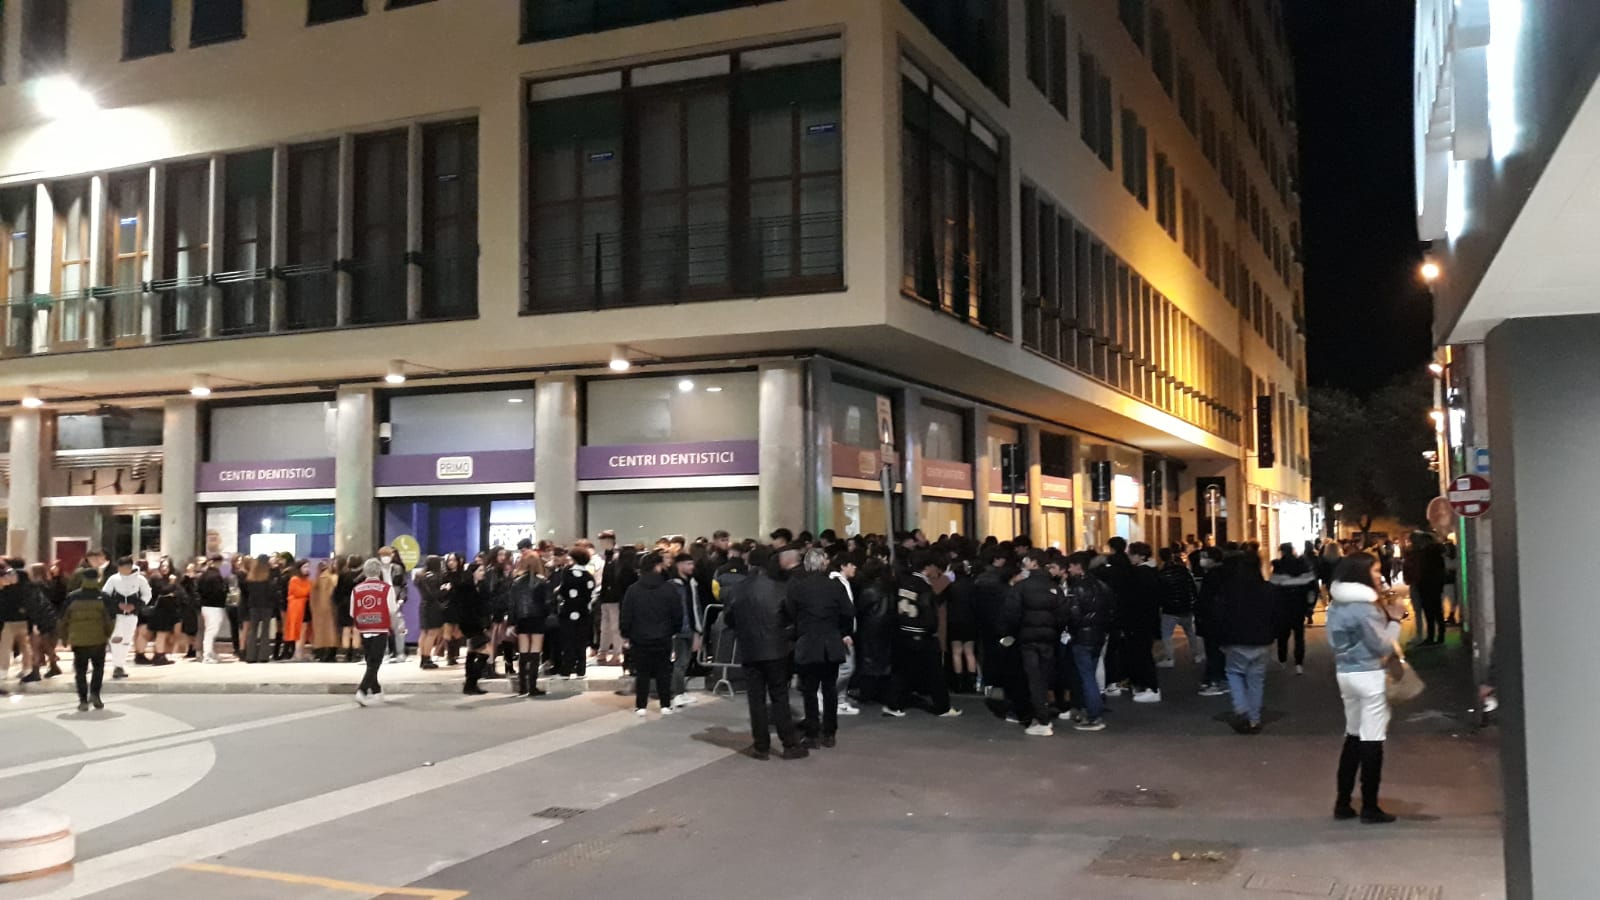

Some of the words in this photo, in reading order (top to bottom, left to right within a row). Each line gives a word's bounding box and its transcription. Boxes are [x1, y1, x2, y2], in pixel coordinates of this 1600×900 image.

[608, 453, 656, 468] CENTRI
[660, 451, 734, 465] DENTISTICI
[218, 470, 255, 482] CENTRI
[257, 467, 316, 480] DENTISTICI
[439, 462, 470, 473] PRIMO
